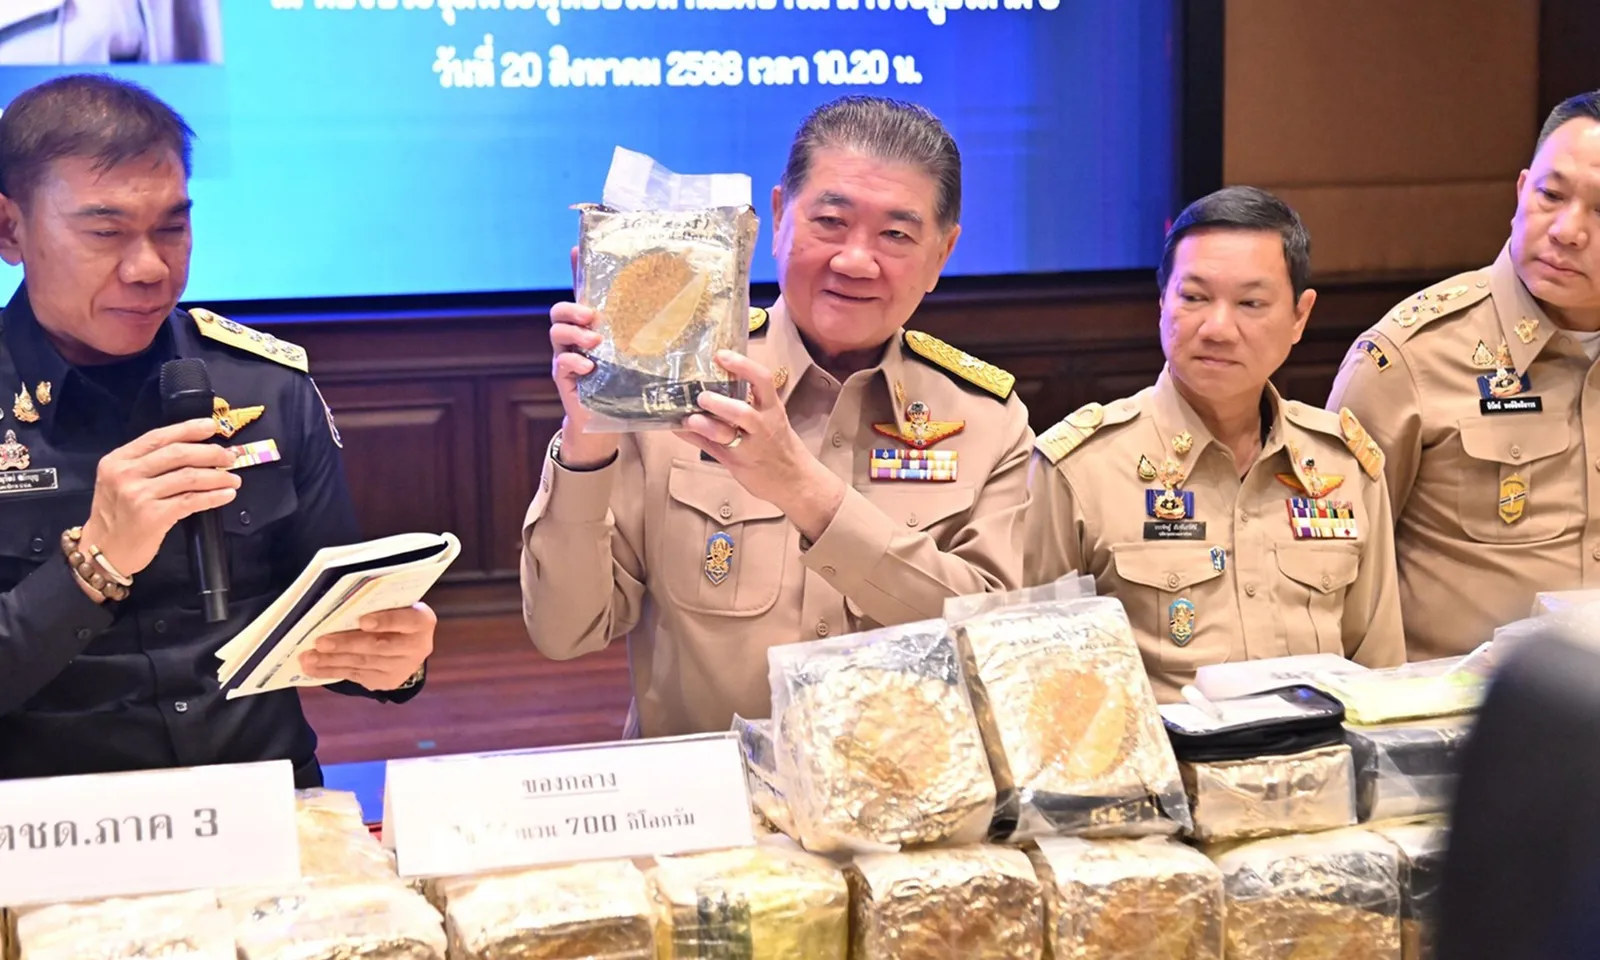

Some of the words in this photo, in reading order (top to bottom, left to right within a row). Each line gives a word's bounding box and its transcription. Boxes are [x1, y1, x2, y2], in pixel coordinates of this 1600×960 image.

[432, 33, 494, 87] วันที่
[501, 51, 543, 87] 20
[549, 45, 661, 87] สิงหาคม
[667, 50, 743, 86] 2568
[749, 56, 809, 85] เวลา
[814, 49, 889, 85] 10.20
[894, 55, 923, 84] น.
[521, 772, 618, 793] ของกลาง
[194, 808, 219, 837] 3
[564, 813, 618, 836] 700
[626, 807, 696, 831] กิโลกรัม
